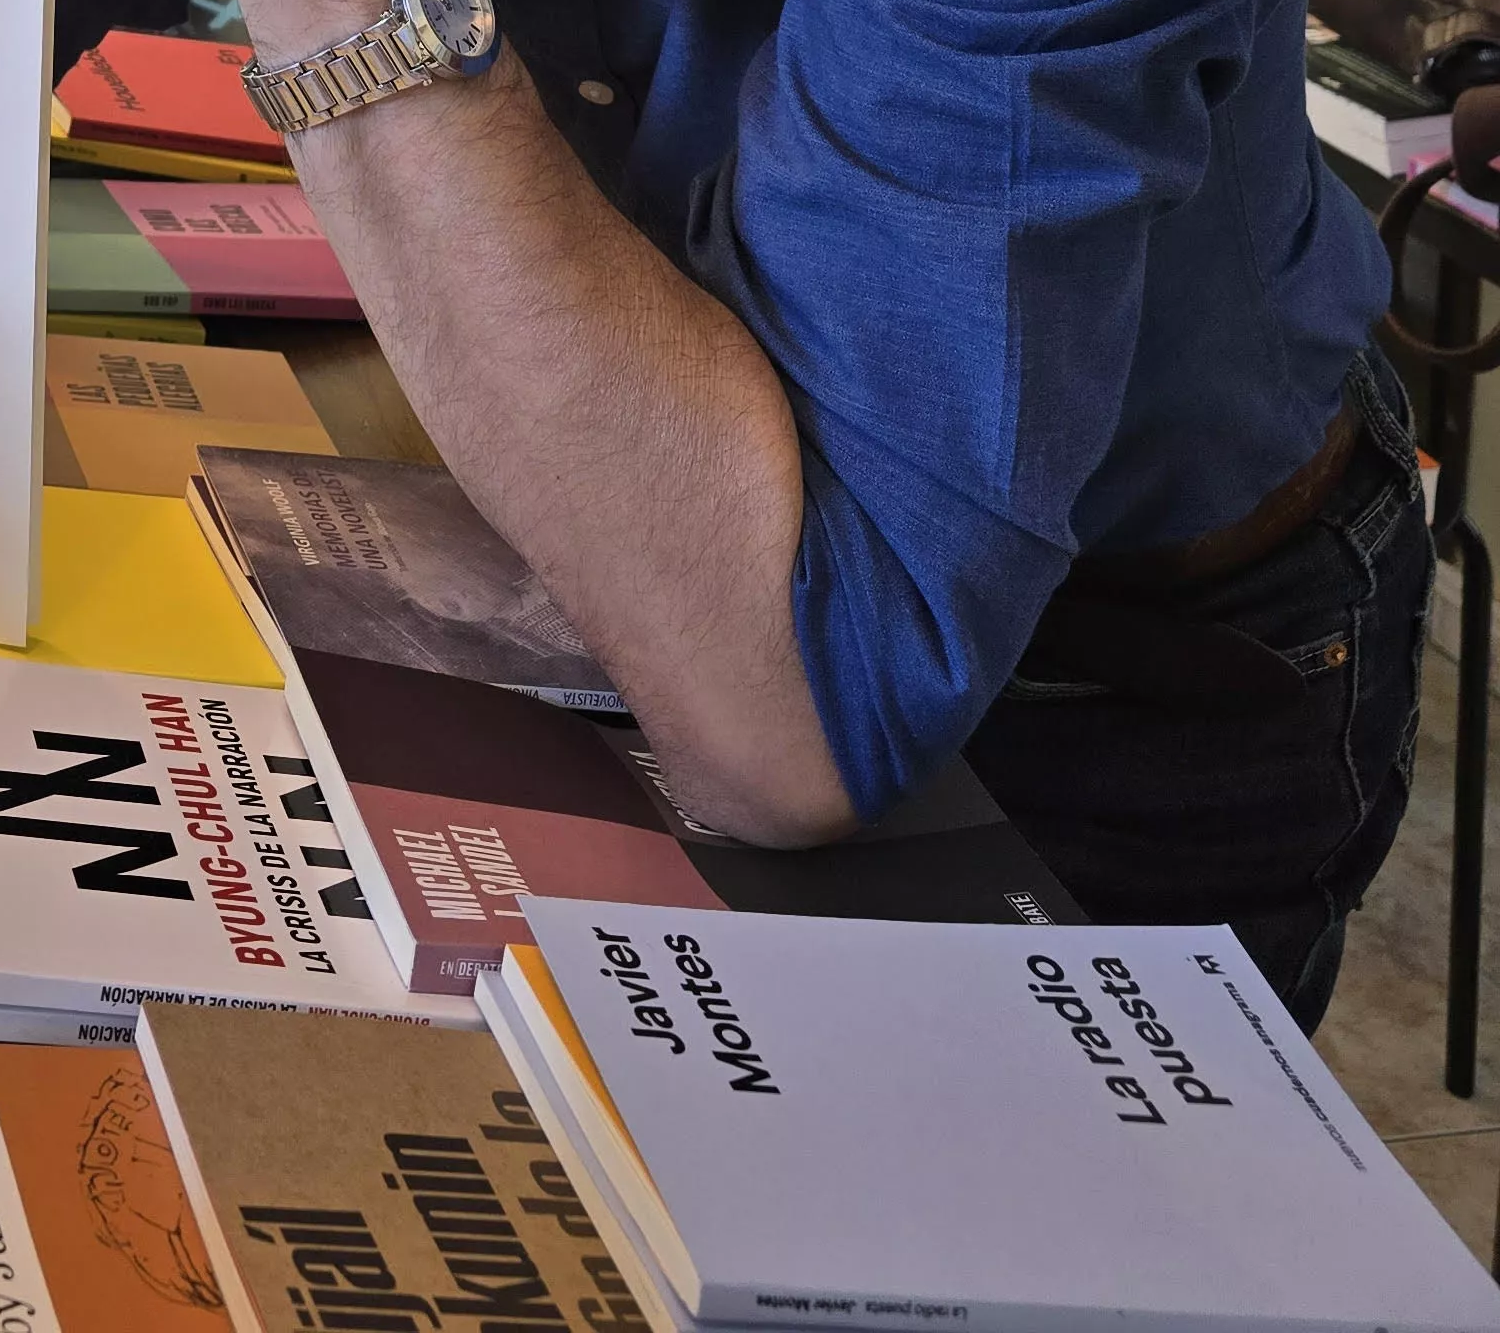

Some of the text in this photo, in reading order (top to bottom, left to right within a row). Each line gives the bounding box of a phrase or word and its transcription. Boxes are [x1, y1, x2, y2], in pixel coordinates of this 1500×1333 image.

[262, 478, 320, 567] VIRGINIA WOOLF
[302, 488, 356, 572] MEMORIAS
[353, 539, 389, 571] UNA
[564, 691, 626, 710] NOVELISTA
[141, 693, 286, 969] BYUNG-CHUL HAN
[197, 698, 337, 976] LA CRISIS DE LA NARRACIÓN
[393, 828, 488, 922] MICHAEL
[449, 823, 537, 897] SANDEL
[440, 961, 454, 977] EN
[592, 926, 686, 1055] Javier
[663, 933, 781, 1094] Montes
[1027, 954, 1168, 1126] La radio
[1091, 957, 1234, 1106] puesta
[1223, 981, 1367, 1173] nuevos cuadernos anagrama
[757, 1293, 810, 1313] Montes
[814, 1296, 855, 1314] Javier
